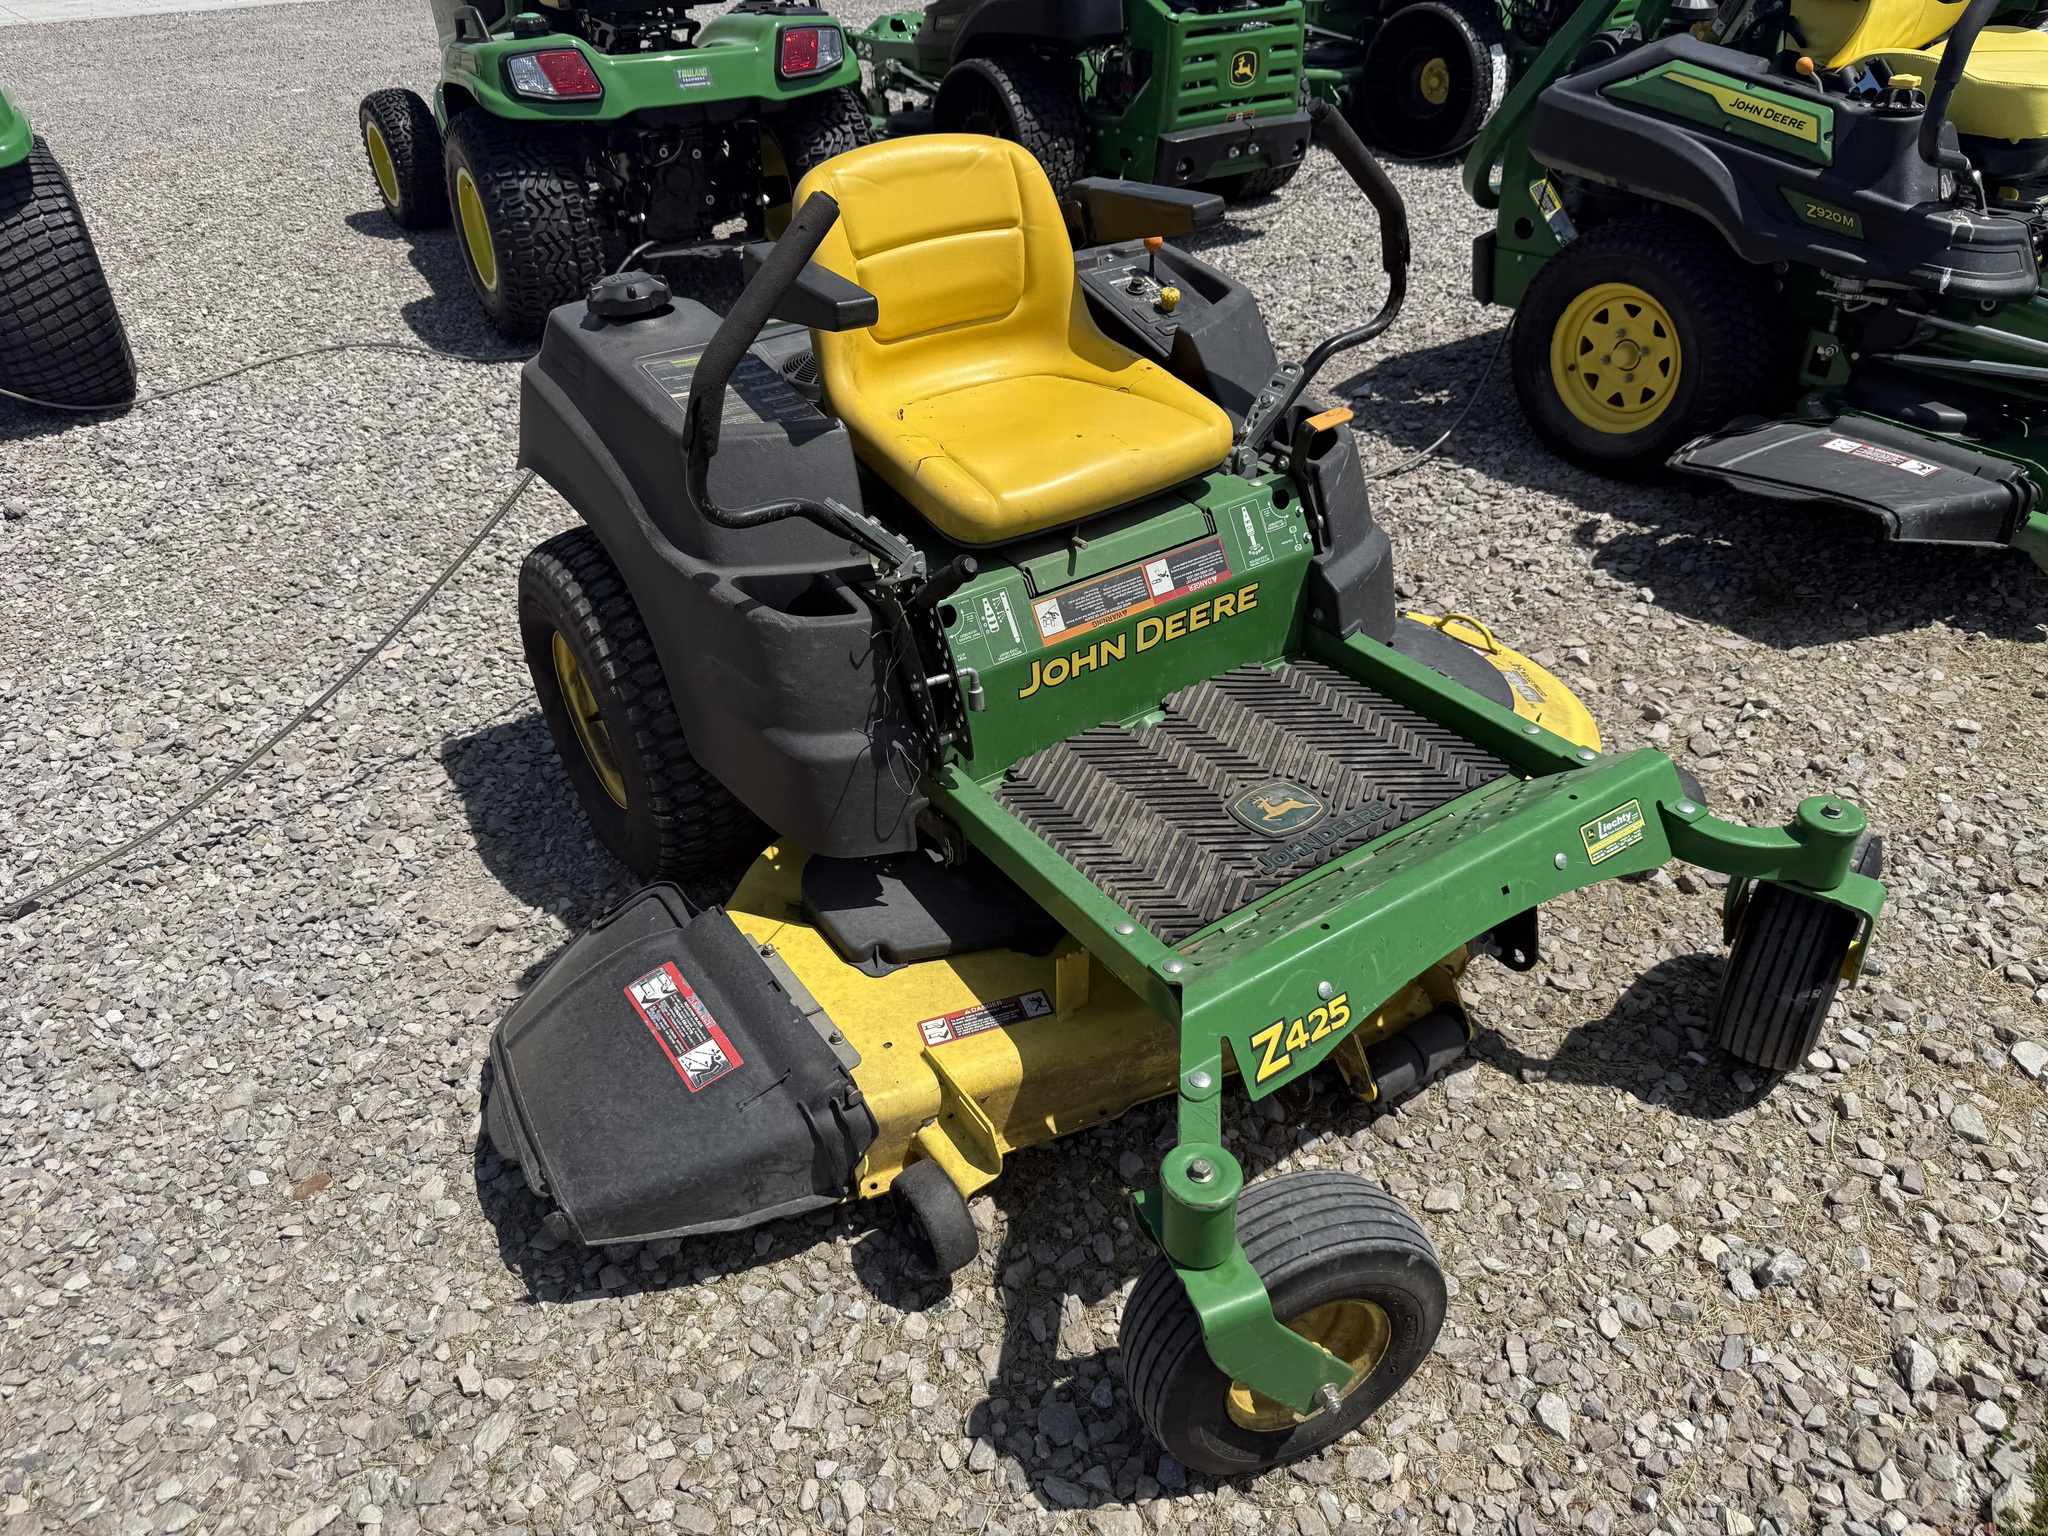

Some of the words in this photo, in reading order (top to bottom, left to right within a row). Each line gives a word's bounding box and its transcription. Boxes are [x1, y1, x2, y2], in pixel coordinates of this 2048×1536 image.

[677, 67, 708, 78] TRULAND
[1729, 98, 1763, 116] JOHN
[1763, 108, 1807, 130] DEERE
[1187, 577, 1212, 591] DANGER
[1091, 611, 1122, 627] WARNING
[1017, 631, 1128, 700] JOHN
[1135, 580, 1260, 655] DEERE
[1256, 831, 1323, 876] JOHN
[1313, 803, 1391, 846] DEERE
[1597, 811, 1632, 840] Liechty
[970, 999, 1002, 1013] DANGER
[1248, 991, 1352, 1088] Z425
